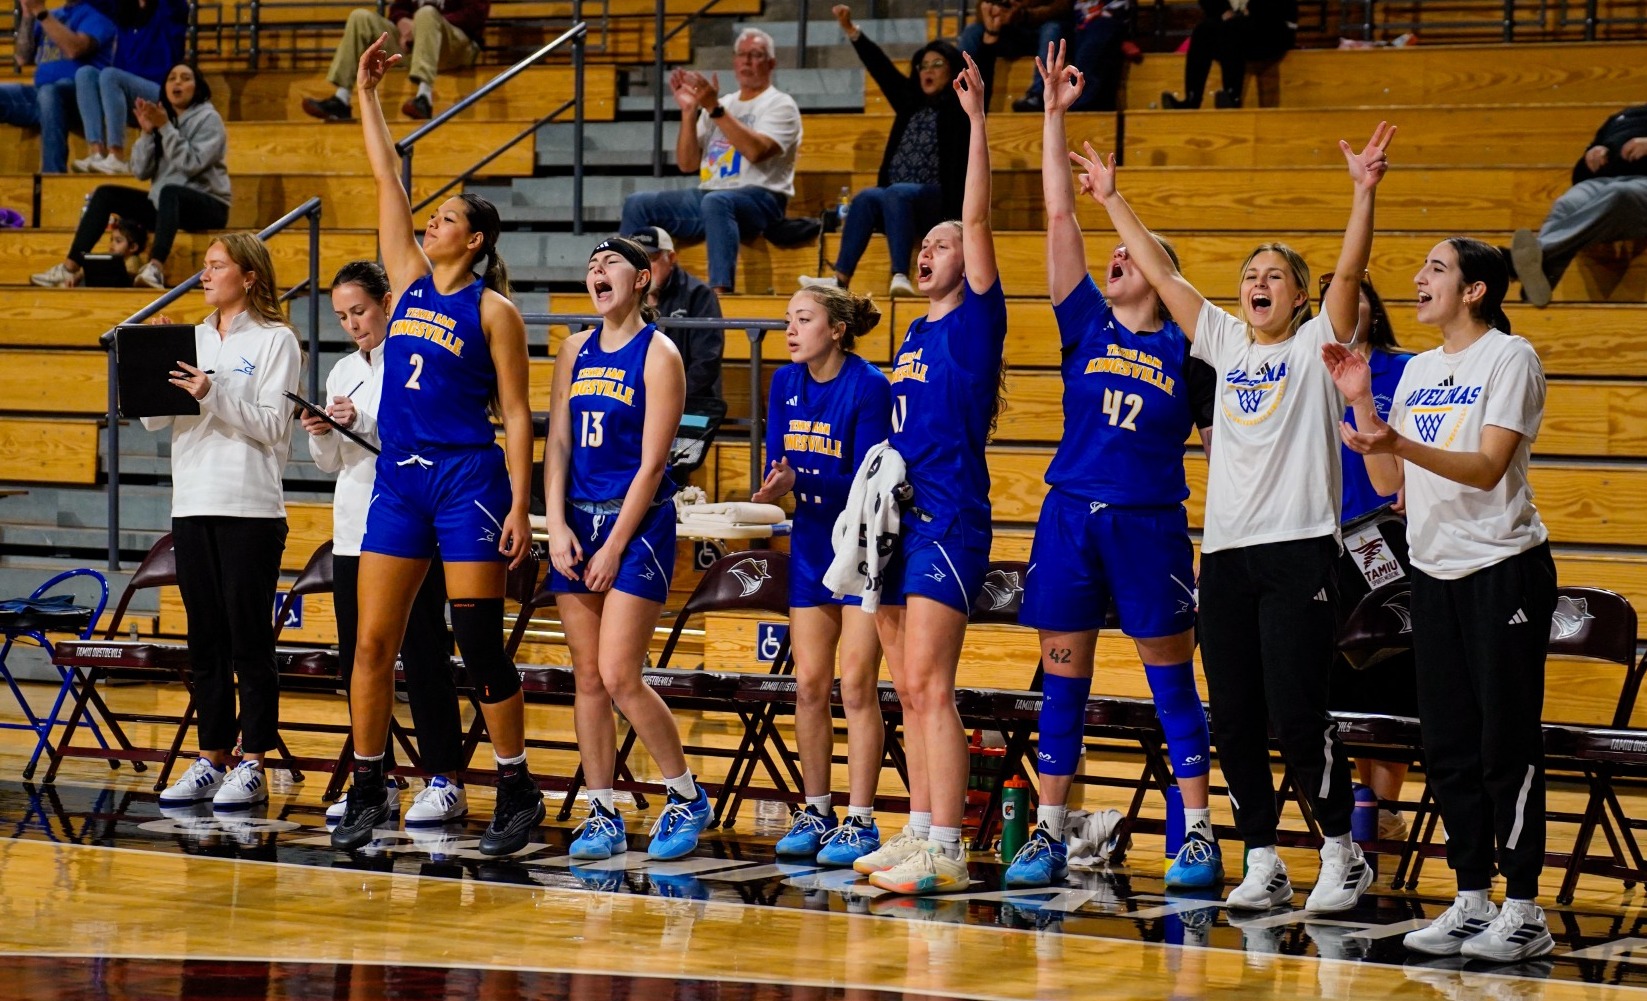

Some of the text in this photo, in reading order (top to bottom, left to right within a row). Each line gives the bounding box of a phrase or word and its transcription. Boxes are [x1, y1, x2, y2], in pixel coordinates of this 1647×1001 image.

[1106, 343, 1138, 362] TEXAS
[405, 354, 424, 390] 2
[1084, 357, 1175, 396] KINGSVILLE
[1103, 387, 1143, 432] 42
[581, 411, 605, 448] 13
[1364, 559, 1398, 581] TAMIU
[76, 647, 93, 657] TAMIU
[1049, 648, 1072, 664] 42
